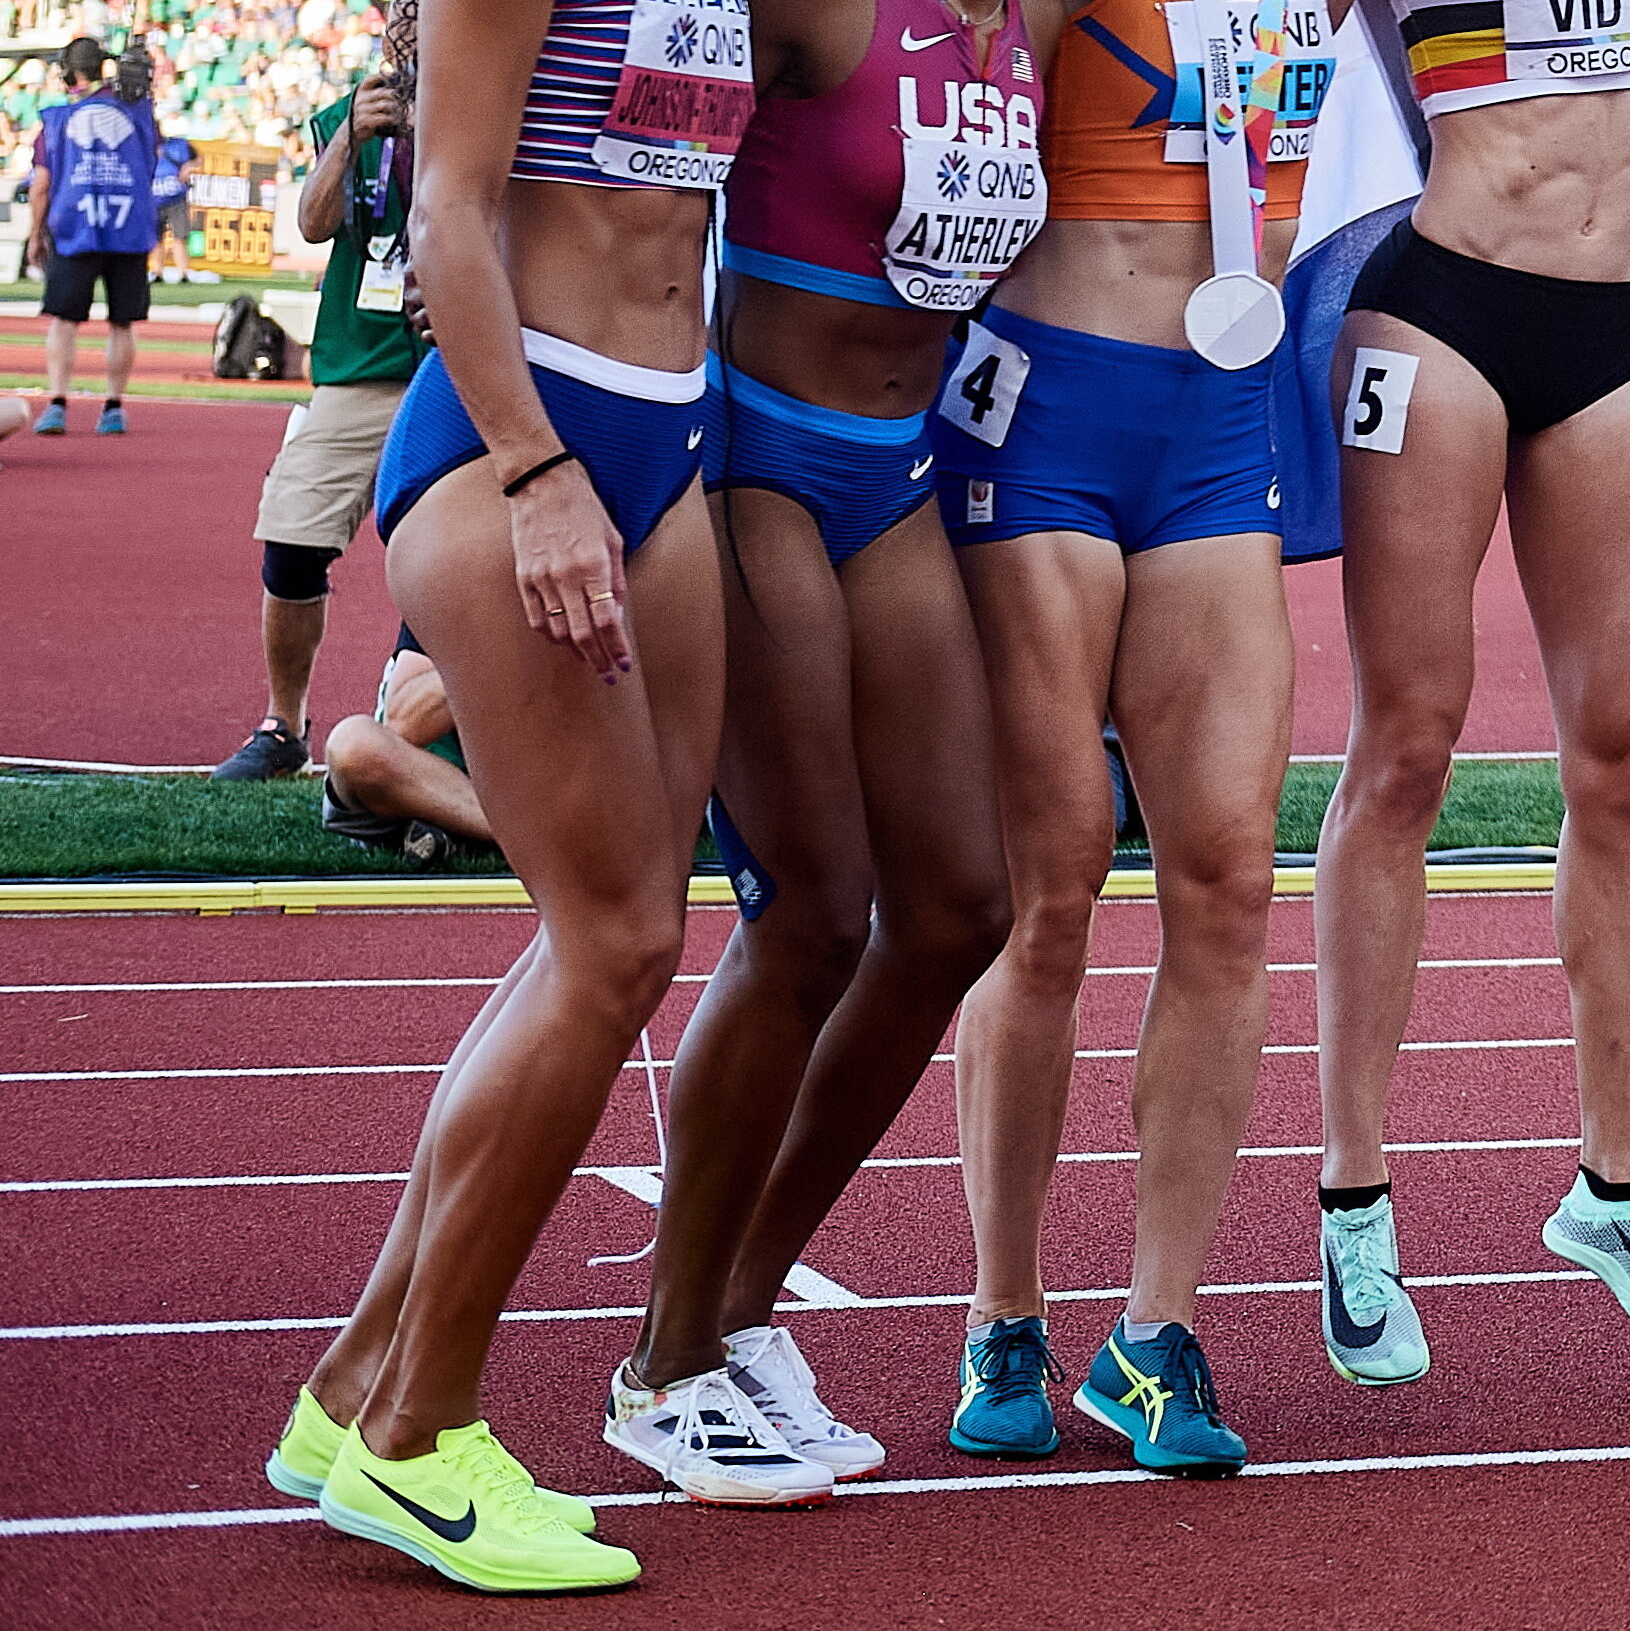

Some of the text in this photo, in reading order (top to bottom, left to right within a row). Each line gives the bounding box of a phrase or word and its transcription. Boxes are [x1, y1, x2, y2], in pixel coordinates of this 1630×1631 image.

[702, 24, 745, 67] QNB
[899, 76, 1038, 150] USA
[628, 151, 732, 183] OREGON2
[978, 160, 1036, 200] QNB
[894, 213, 1039, 264] ATHERLEY
[960, 353, 1001, 425] 4
[1354, 366, 1388, 436] 5
